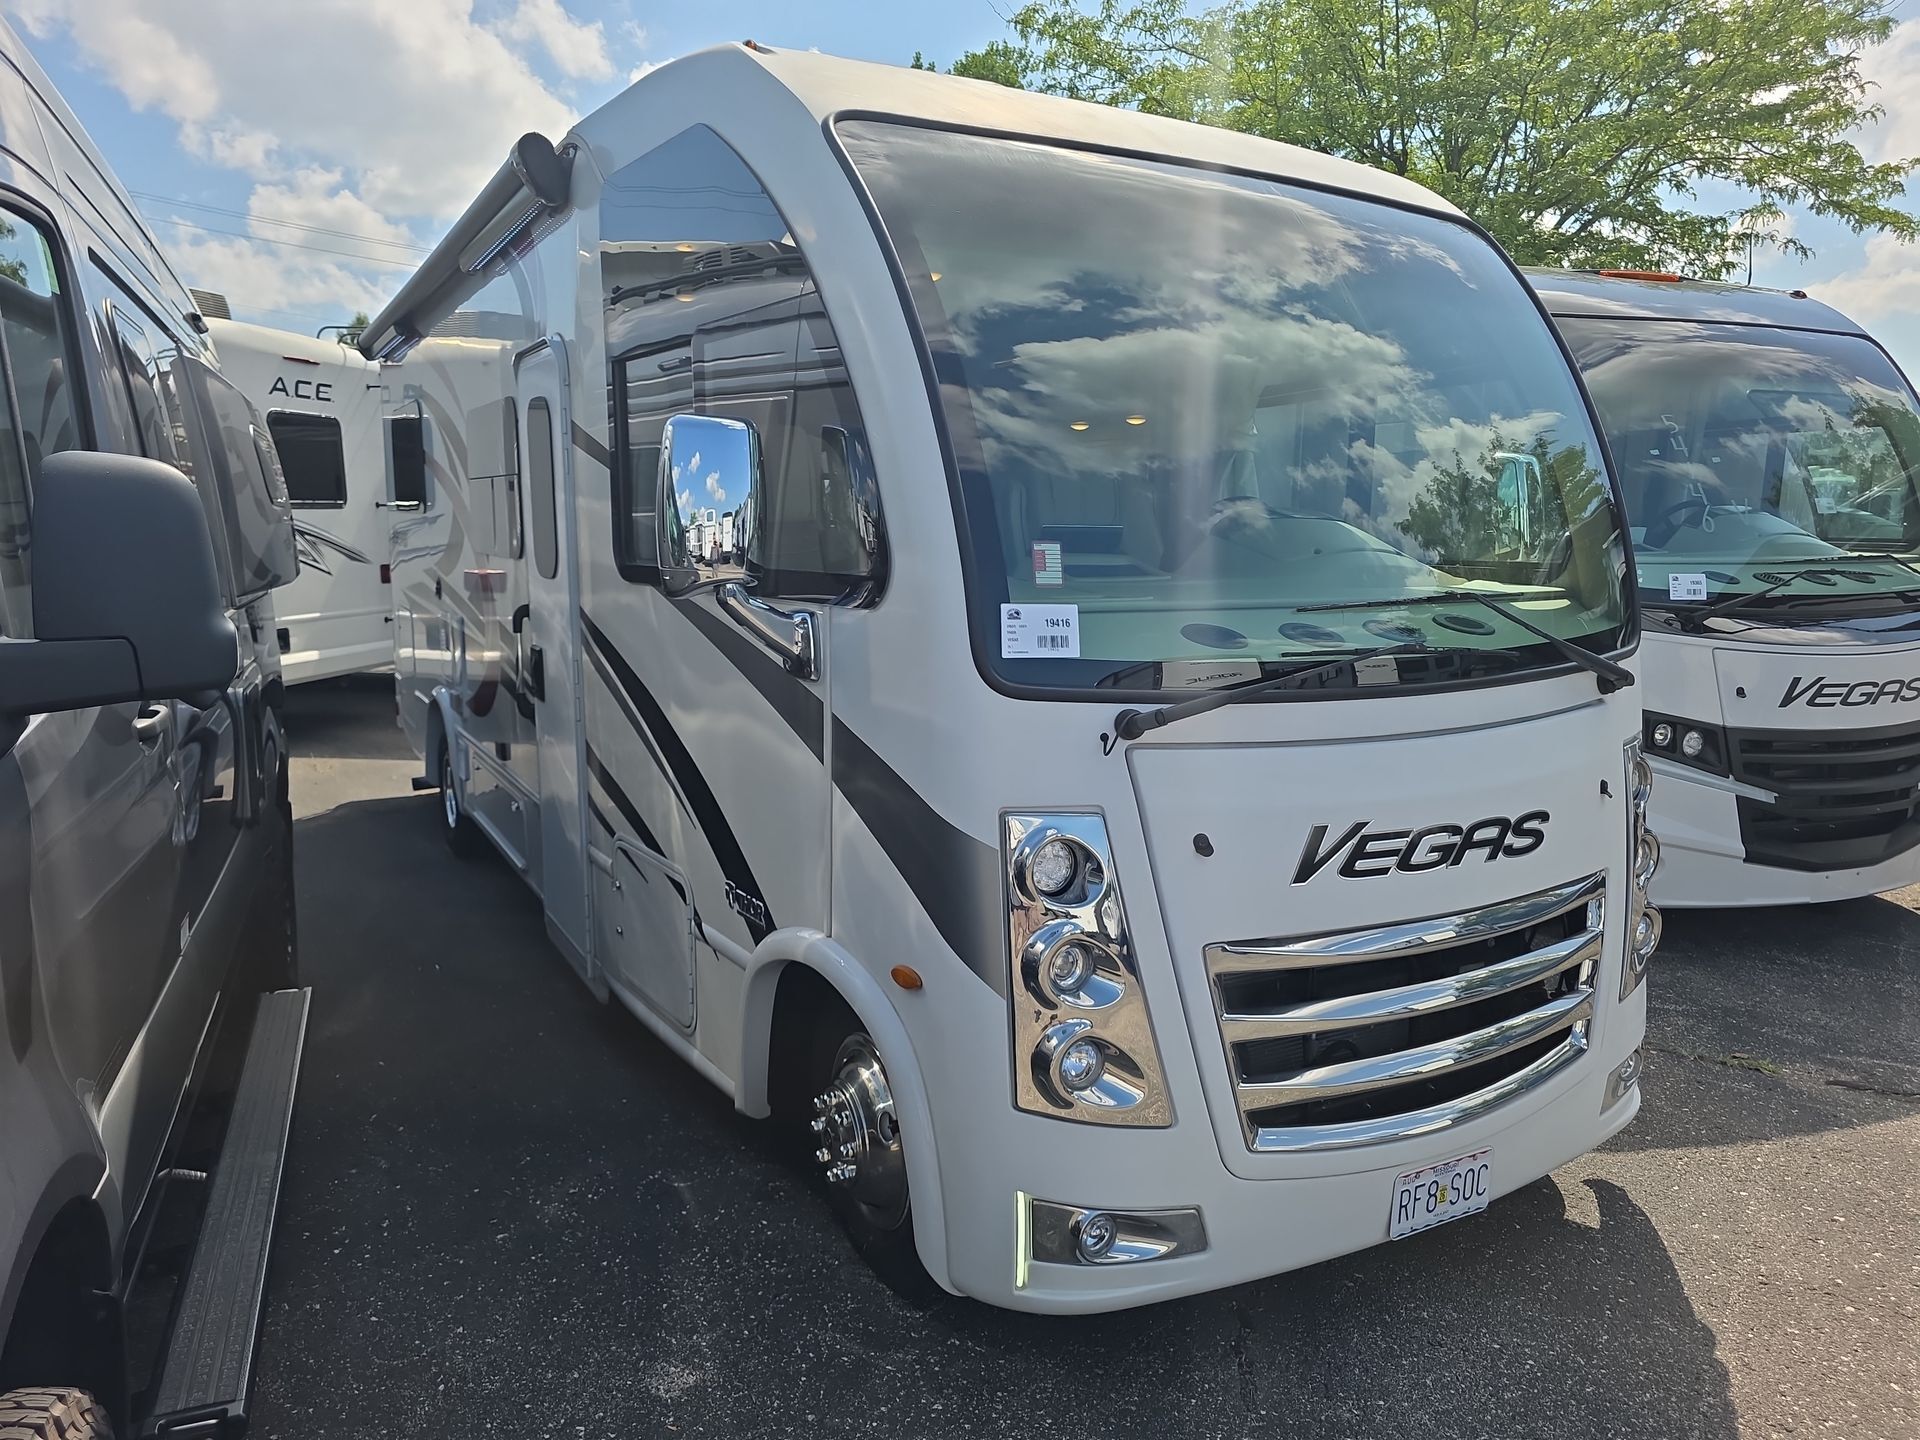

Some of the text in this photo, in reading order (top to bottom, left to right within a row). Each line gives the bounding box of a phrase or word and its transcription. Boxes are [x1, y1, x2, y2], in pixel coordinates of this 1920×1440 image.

[1045, 618, 1071, 628] 19416
[1290, 808, 1551, 887] VEGAS
[1397, 1179, 1440, 1224] RF8
